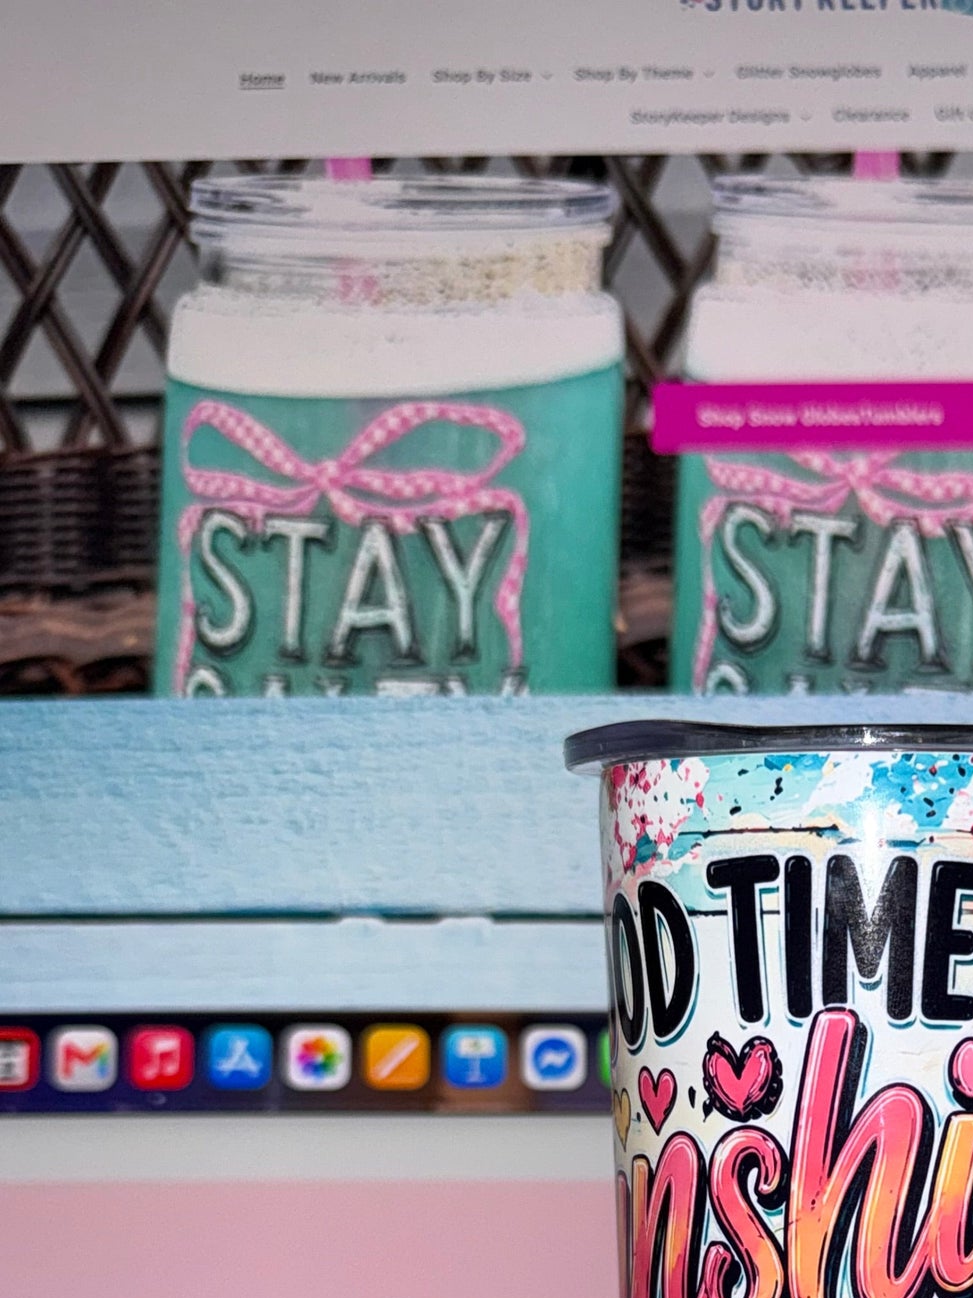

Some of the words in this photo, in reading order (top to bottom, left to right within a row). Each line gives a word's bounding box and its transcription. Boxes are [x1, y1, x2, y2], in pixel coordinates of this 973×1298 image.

[309, 71, 345, 84] New
[349, 70, 406, 84] Arrivals
[432, 69, 472, 84] Shop
[475, 69, 495, 85] By
[500, 70, 532, 83] Size
[573, 68, 615, 83] Shop
[617, 67, 638, 83] By
[642, 66, 694, 81] Theme
[907, 64, 967, 80] Apparel
[239, 73, 285, 90] Home
[727, 108, 791, 125] Designs
[832, 106, 910, 122] Clearance
[934, 104, 965, 122] Gift
[696, 402, 745, 430] Shop
[197, 506, 515, 665] STAY
